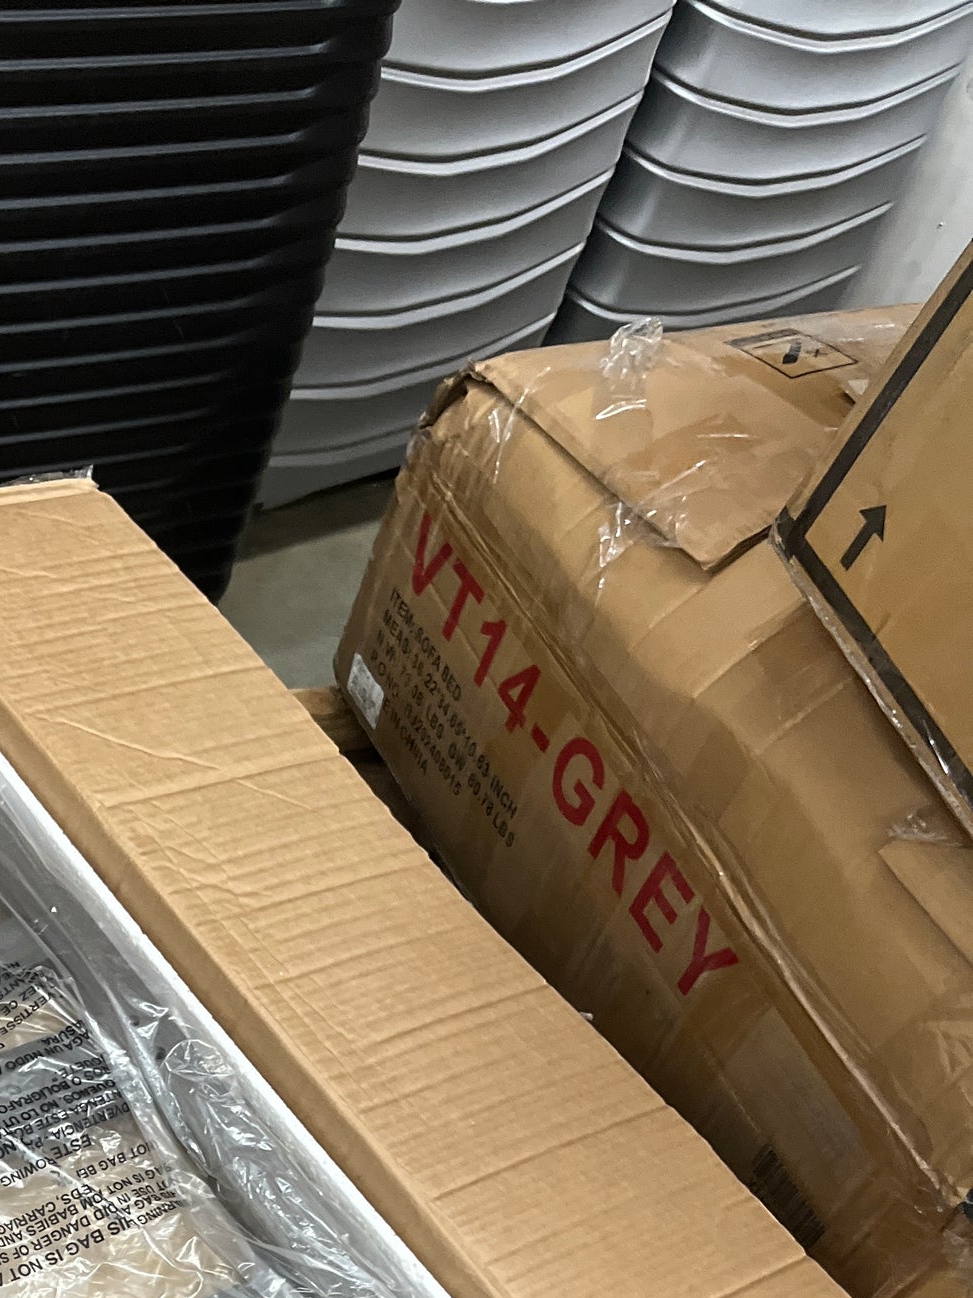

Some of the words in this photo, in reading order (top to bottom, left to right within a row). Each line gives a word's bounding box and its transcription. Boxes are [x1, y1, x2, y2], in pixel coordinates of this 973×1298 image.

[414, 625, 443, 674] SOFA
[439, 663, 464, 705] BED
[408, 512, 738, 995] VT14-GREY
[489, 773, 517, 820] INCH
[491, 809, 516, 850] LBS
[0, 998, 19, 1016] CE
[4, 1048, 40, 1070] NUDO
[69, 1074, 81, 1087] O
[19, 1107, 38, 1121] LO
[38, 1098, 57, 1113] NO
[33, 1108, 68, 1130] ESTE
[50, 1133, 92, 1160] ESTE
[98, 1151, 126, 1171] BAG
[105, 1176, 131, 1194] NOT
[131, 1172, 143, 1183] IS
[117, 1192, 130, 1205] IN
[131, 1183, 153, 1198] USE
[133, 1191, 161, 1210] BAG
[24, 1204, 78, 1236] BABIES
[30, 1215, 90, 1250] DANGER
[64, 1228, 105, 1256] BAG
[10, 1243, 29, 1259] OF
[43, 1249, 63, 1266] IS
[6, 1257, 42, 1282] NOT
